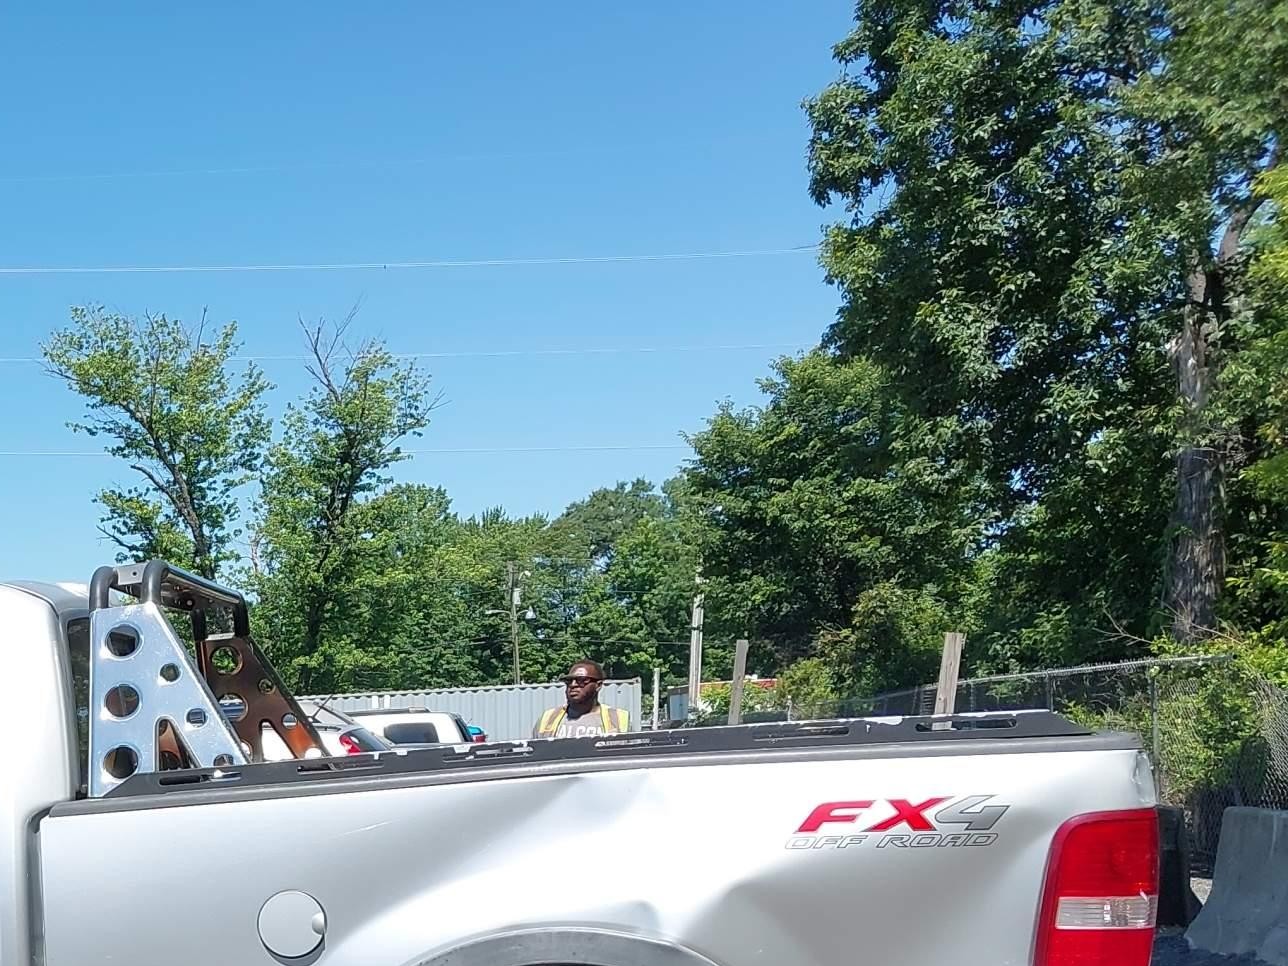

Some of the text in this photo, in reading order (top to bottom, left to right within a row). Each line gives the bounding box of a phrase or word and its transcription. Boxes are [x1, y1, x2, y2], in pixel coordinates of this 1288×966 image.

[794, 795, 1010, 833] FX4
[785, 833, 999, 849] OFF ROAD
